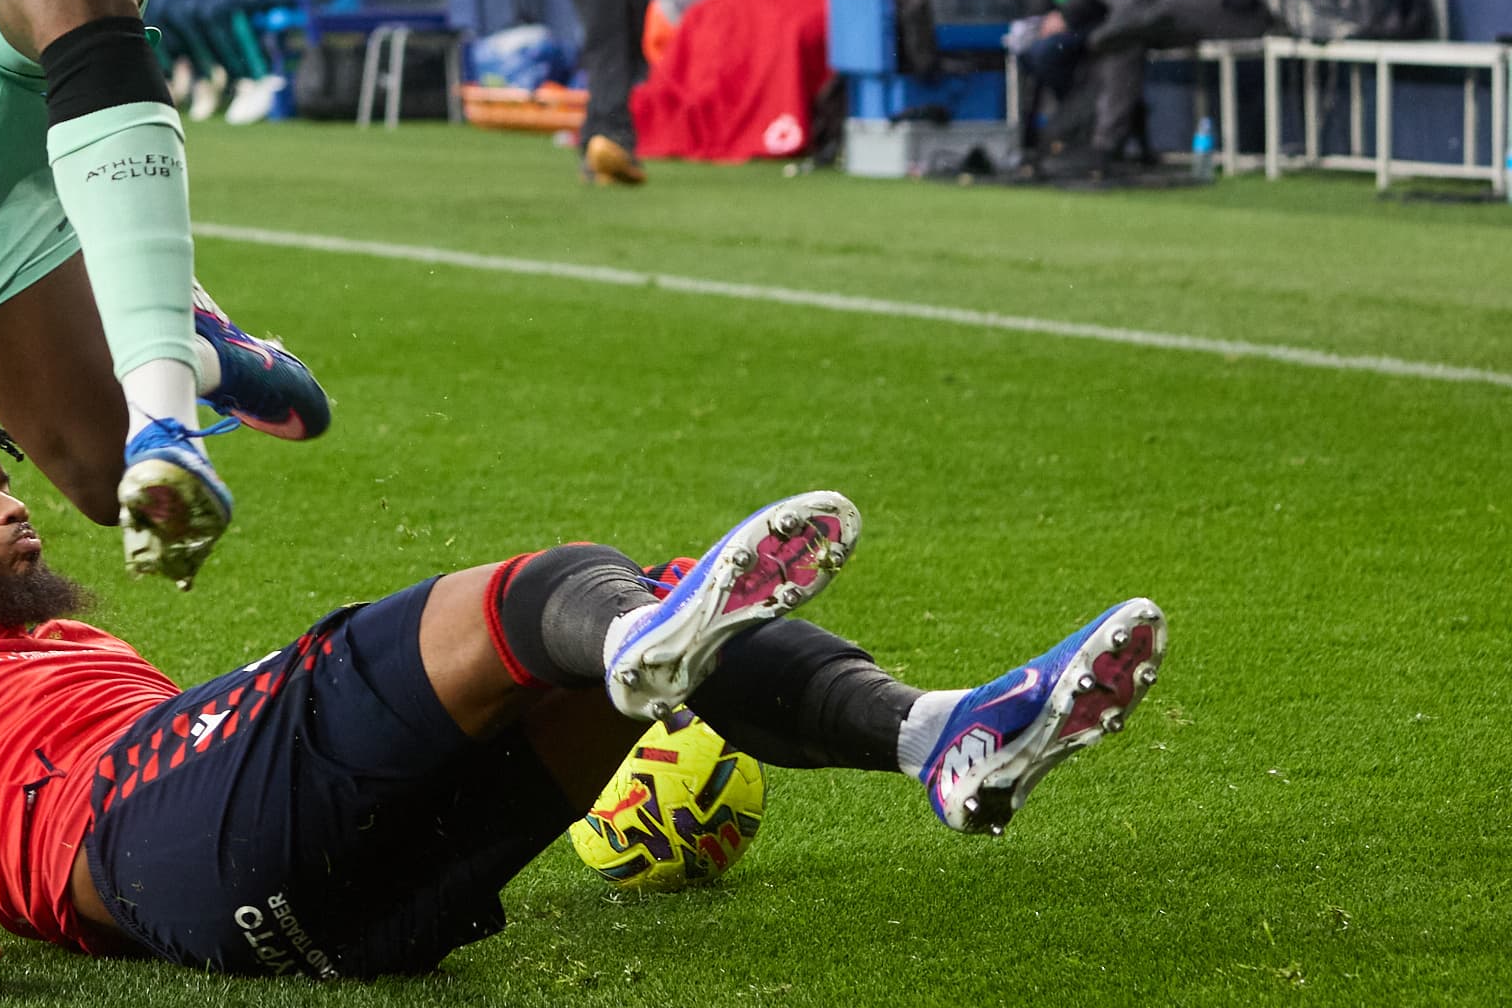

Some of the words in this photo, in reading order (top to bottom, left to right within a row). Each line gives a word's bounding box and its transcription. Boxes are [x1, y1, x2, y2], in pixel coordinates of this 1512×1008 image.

[86, 154, 183, 182] ATHLETIC
[111, 166, 170, 181] CLUB
[267, 892, 313, 954] TRADER
